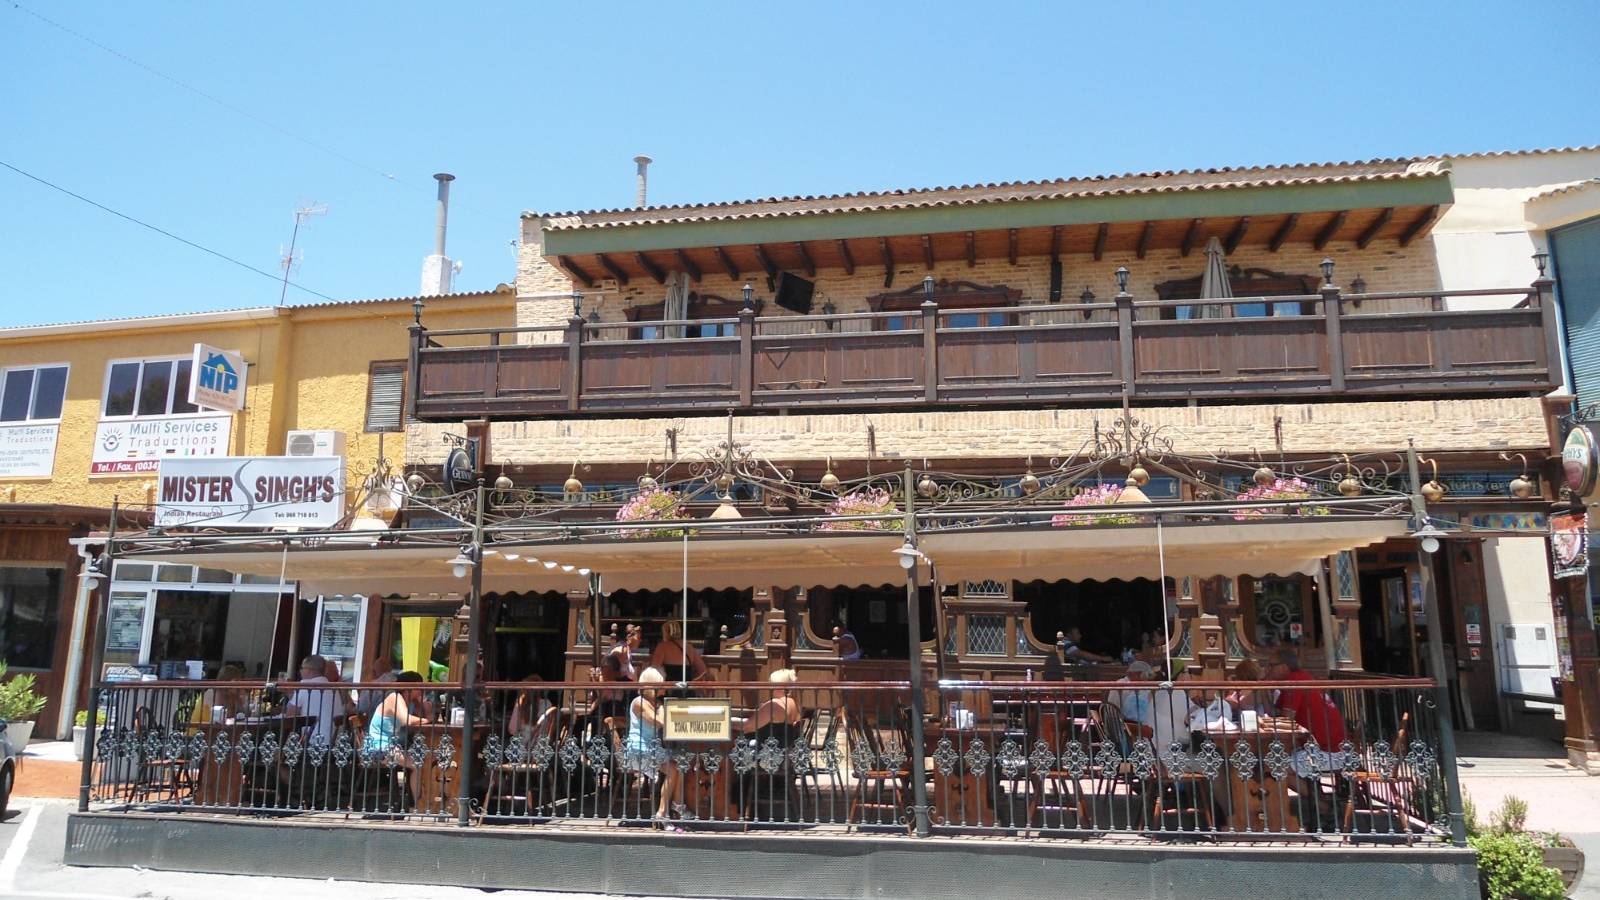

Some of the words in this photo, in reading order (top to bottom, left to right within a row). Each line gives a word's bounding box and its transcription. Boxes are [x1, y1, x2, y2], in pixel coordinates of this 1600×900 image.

[129, 422, 161, 435] Multi
[164, 420, 219, 434] Services
[128, 435, 217, 448] Traductions
[97, 463, 111, 473] Tel.
[117, 462, 133, 473] Fax.
[161, 475, 233, 503] MISTER
[254, 475, 334, 503] SINGH'S
[163, 510, 185, 518] Indian
[186, 510, 223, 518] Restaurant
